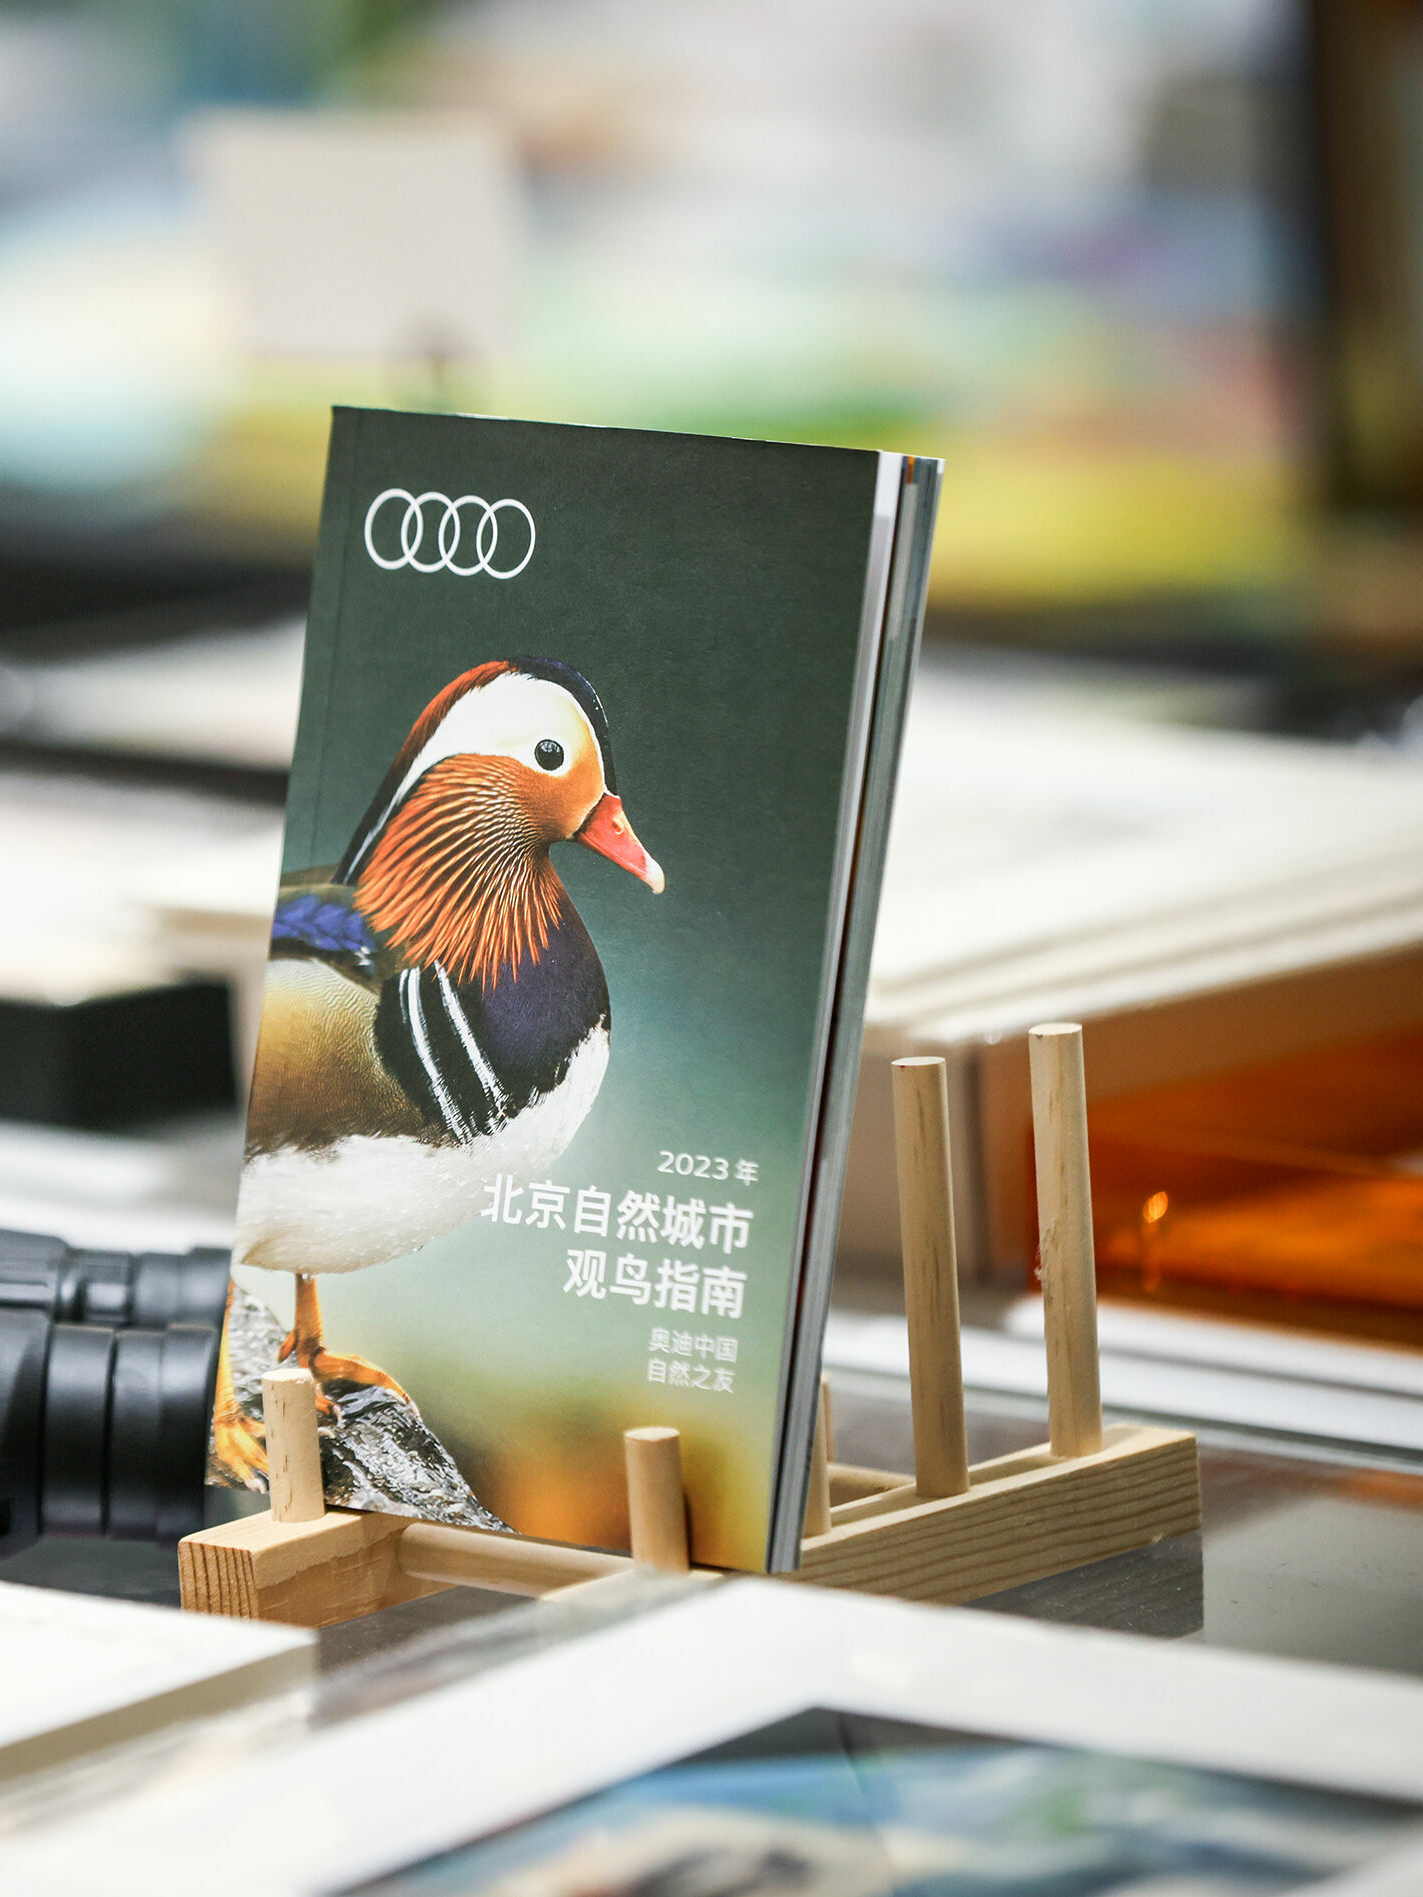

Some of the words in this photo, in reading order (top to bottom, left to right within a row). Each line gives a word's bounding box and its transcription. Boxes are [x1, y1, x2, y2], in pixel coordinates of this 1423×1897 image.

[480, 1173, 754, 1255] 北京自然城市
[562, 1248, 748, 1320] 观鸟指南
[648, 1327, 739, 1364] 奥迪中国
[647, 1358, 736, 1394] 自然之友
